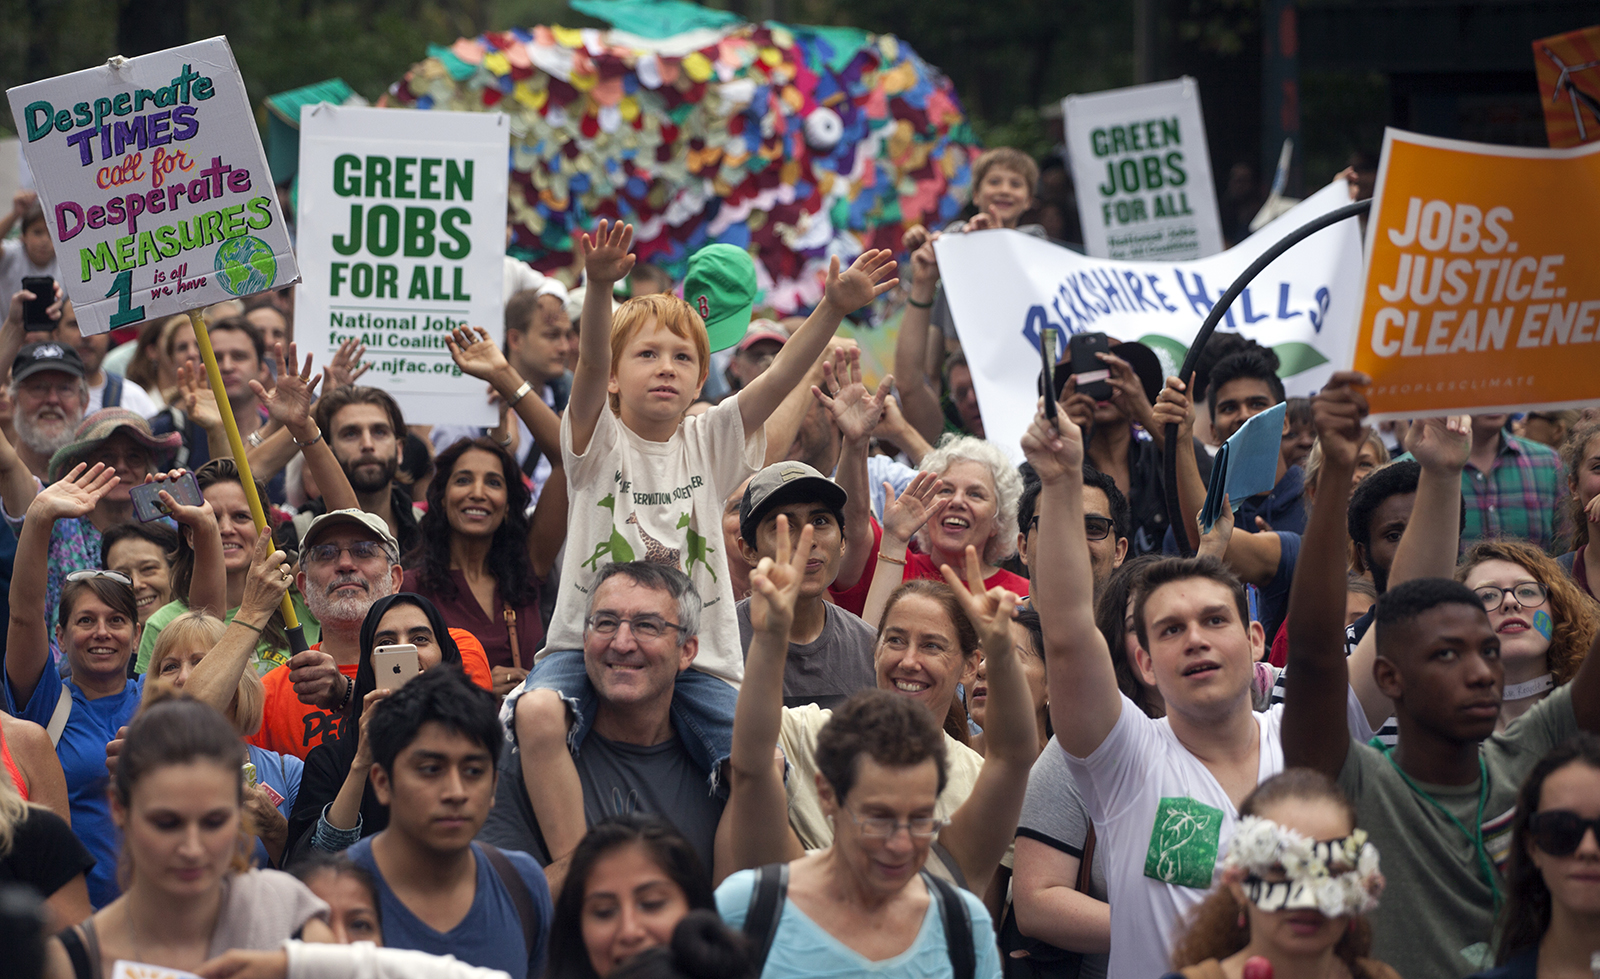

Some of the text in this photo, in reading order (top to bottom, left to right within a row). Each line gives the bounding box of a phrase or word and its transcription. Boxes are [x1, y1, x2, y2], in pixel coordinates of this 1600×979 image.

[24, 63, 215, 143] Desperate
[67, 105, 200, 167] TIMES
[1091, 116, 1181, 158] GREEN
[96, 147, 195, 190] call for
[333, 153, 474, 202] GREEN
[1100, 151, 1187, 196] JOBS
[55, 156, 251, 242] Desperate
[1102, 192, 1194, 227] FOR ALL
[79, 197, 271, 282] MEASURES
[332, 203, 472, 260] JOBS
[1387, 196, 1518, 255] JOBS.
[105, 262, 188, 331] 1 is all
[150, 276, 207, 300] we have
[330, 262, 471, 302] FOR ALL
[1378, 252, 1566, 306] JUSTICE.
[330, 312, 417, 330] National
[697, 294, 709, 319] B
[1022, 268, 1330, 363] BERKSHIRE HILLS
[1371, 300, 1600, 358] CLEAN ENE
[360, 333, 383, 346] All
[387, 333, 455, 349] Coaliti
